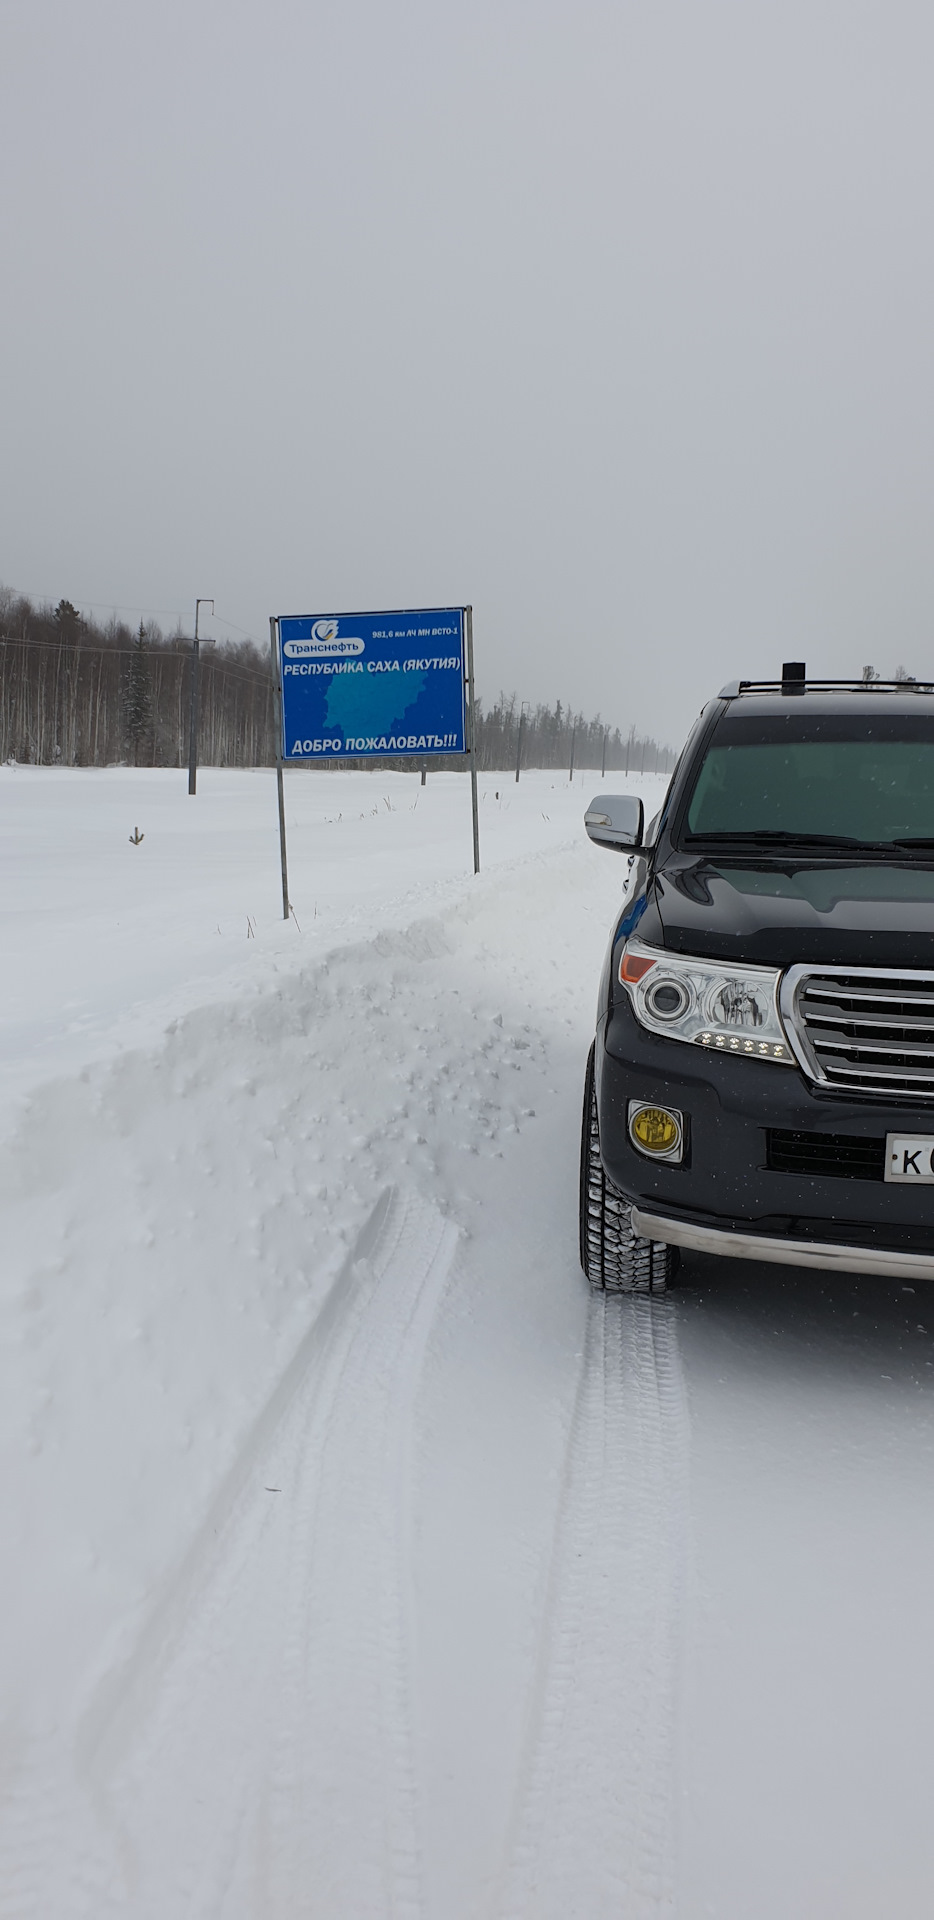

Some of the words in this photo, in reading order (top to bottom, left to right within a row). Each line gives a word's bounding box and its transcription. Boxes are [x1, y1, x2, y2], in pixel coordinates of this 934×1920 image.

[372, 630, 393, 639] 981,6
[406, 629, 417, 637] ЛЧ
[418, 628, 430, 636] МН
[432, 627, 458, 635] ВСТО-1
[289, 643, 359, 654] Транснефть
[284, 662, 363, 676] РЕСПУБЛИКА
[367, 660, 400, 672] САХА
[403, 657, 460, 673] (ЯКУТИЯ)
[292, 739, 342, 754] ДОБРО
[345, 734, 457, 750] ПОЖАЛОВАТЬ!!!
